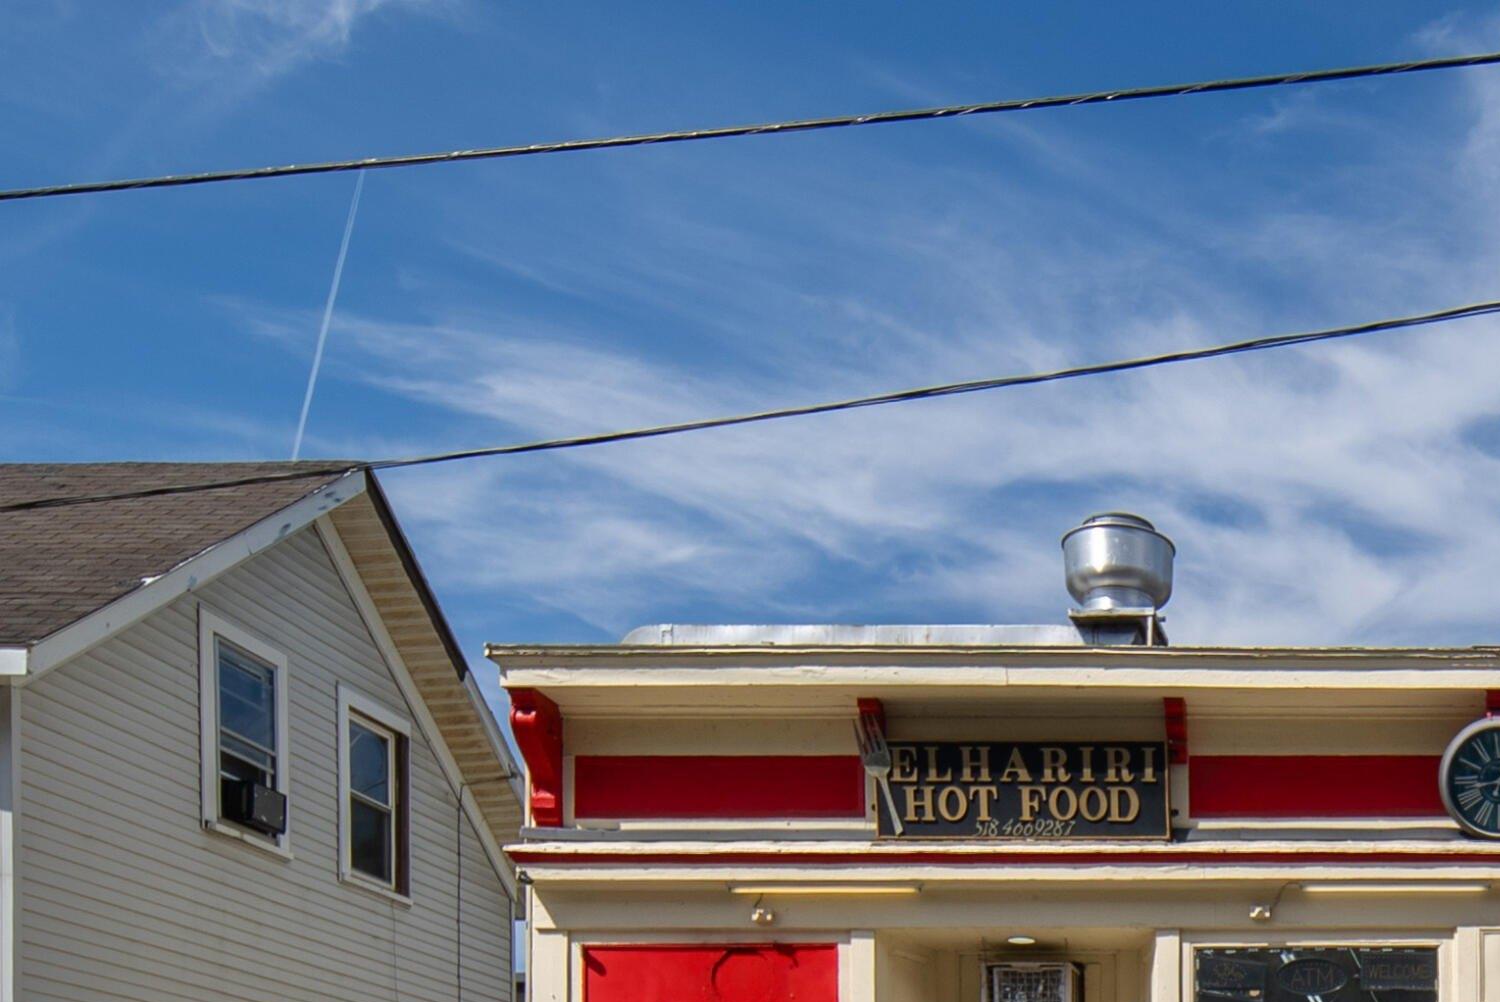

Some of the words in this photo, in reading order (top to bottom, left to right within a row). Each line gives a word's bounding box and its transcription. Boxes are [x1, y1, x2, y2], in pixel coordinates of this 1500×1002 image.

[890, 745, 1158, 784] ELHARIRI
[903, 785, 998, 823] HOT
[1018, 785, 1142, 823] FOOD
[1290, 965, 1335, 988] ATM
